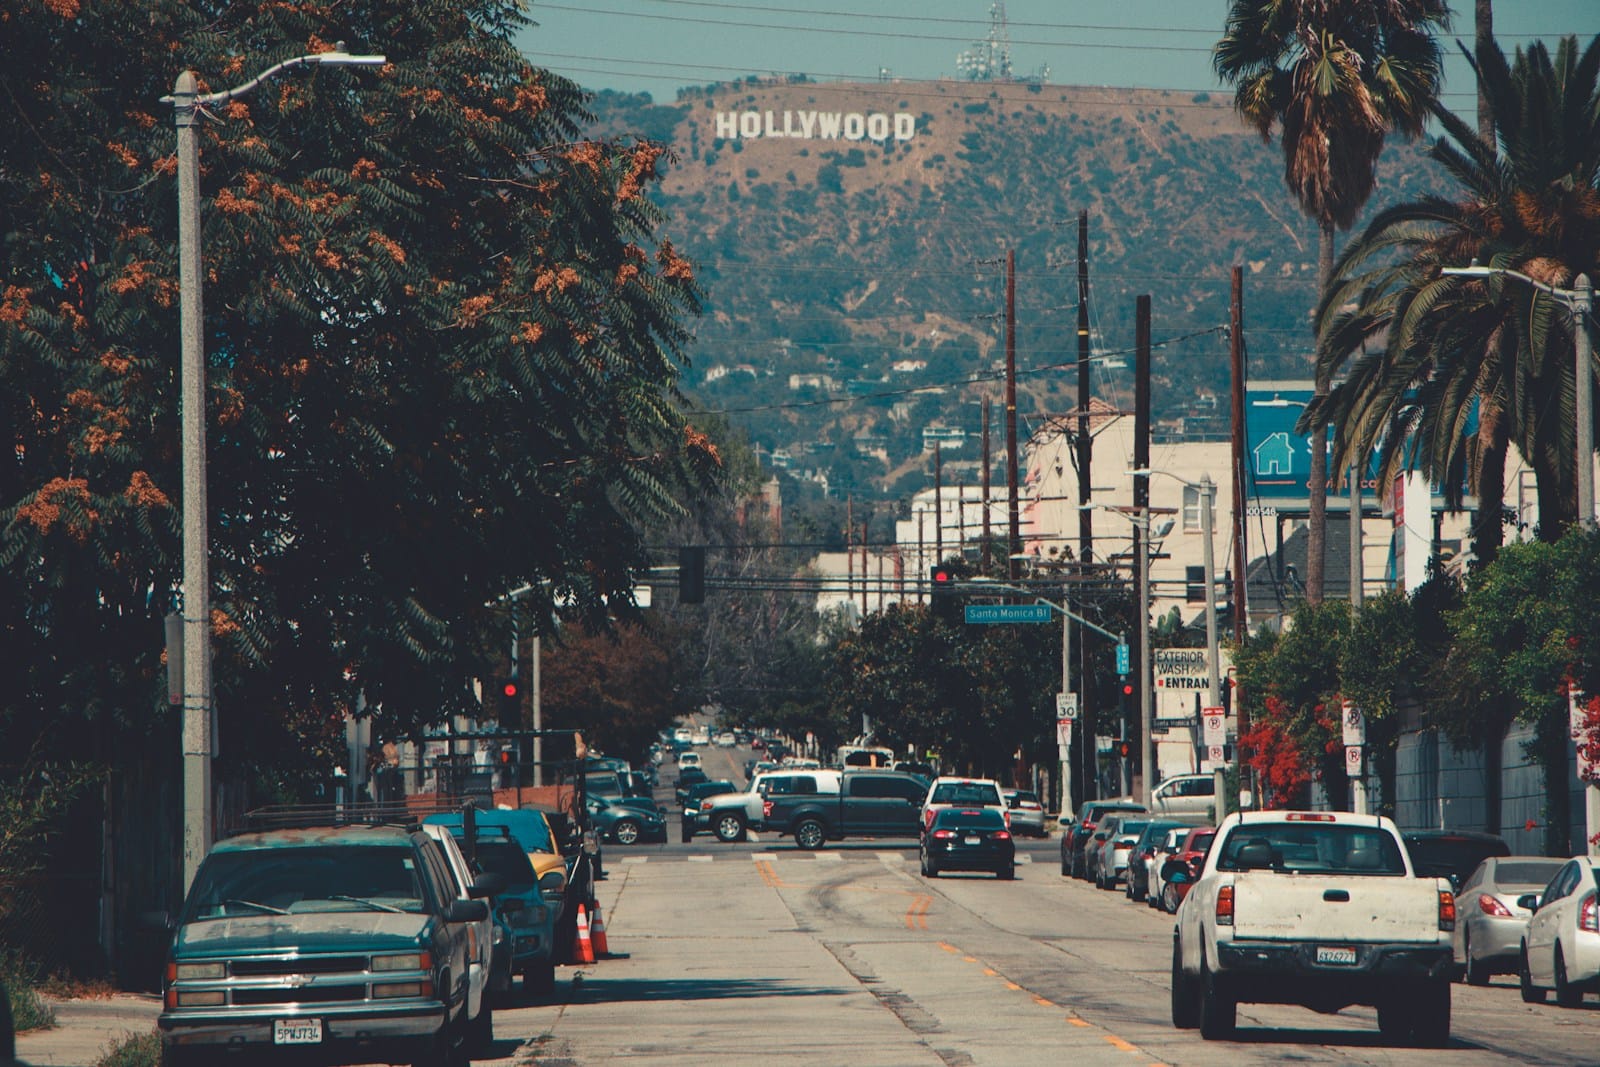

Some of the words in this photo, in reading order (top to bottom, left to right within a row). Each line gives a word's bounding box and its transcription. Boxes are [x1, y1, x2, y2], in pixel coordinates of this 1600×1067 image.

[716, 110, 915, 140] HOLLYWOOD
[969, 608, 998, 618] Santa
[1000, 608, 1034, 617] Monica
[1157, 651, 1204, 663] EXTERIOR
[1158, 664, 1189, 675] WASH
[1059, 706, 1075, 717] 30
